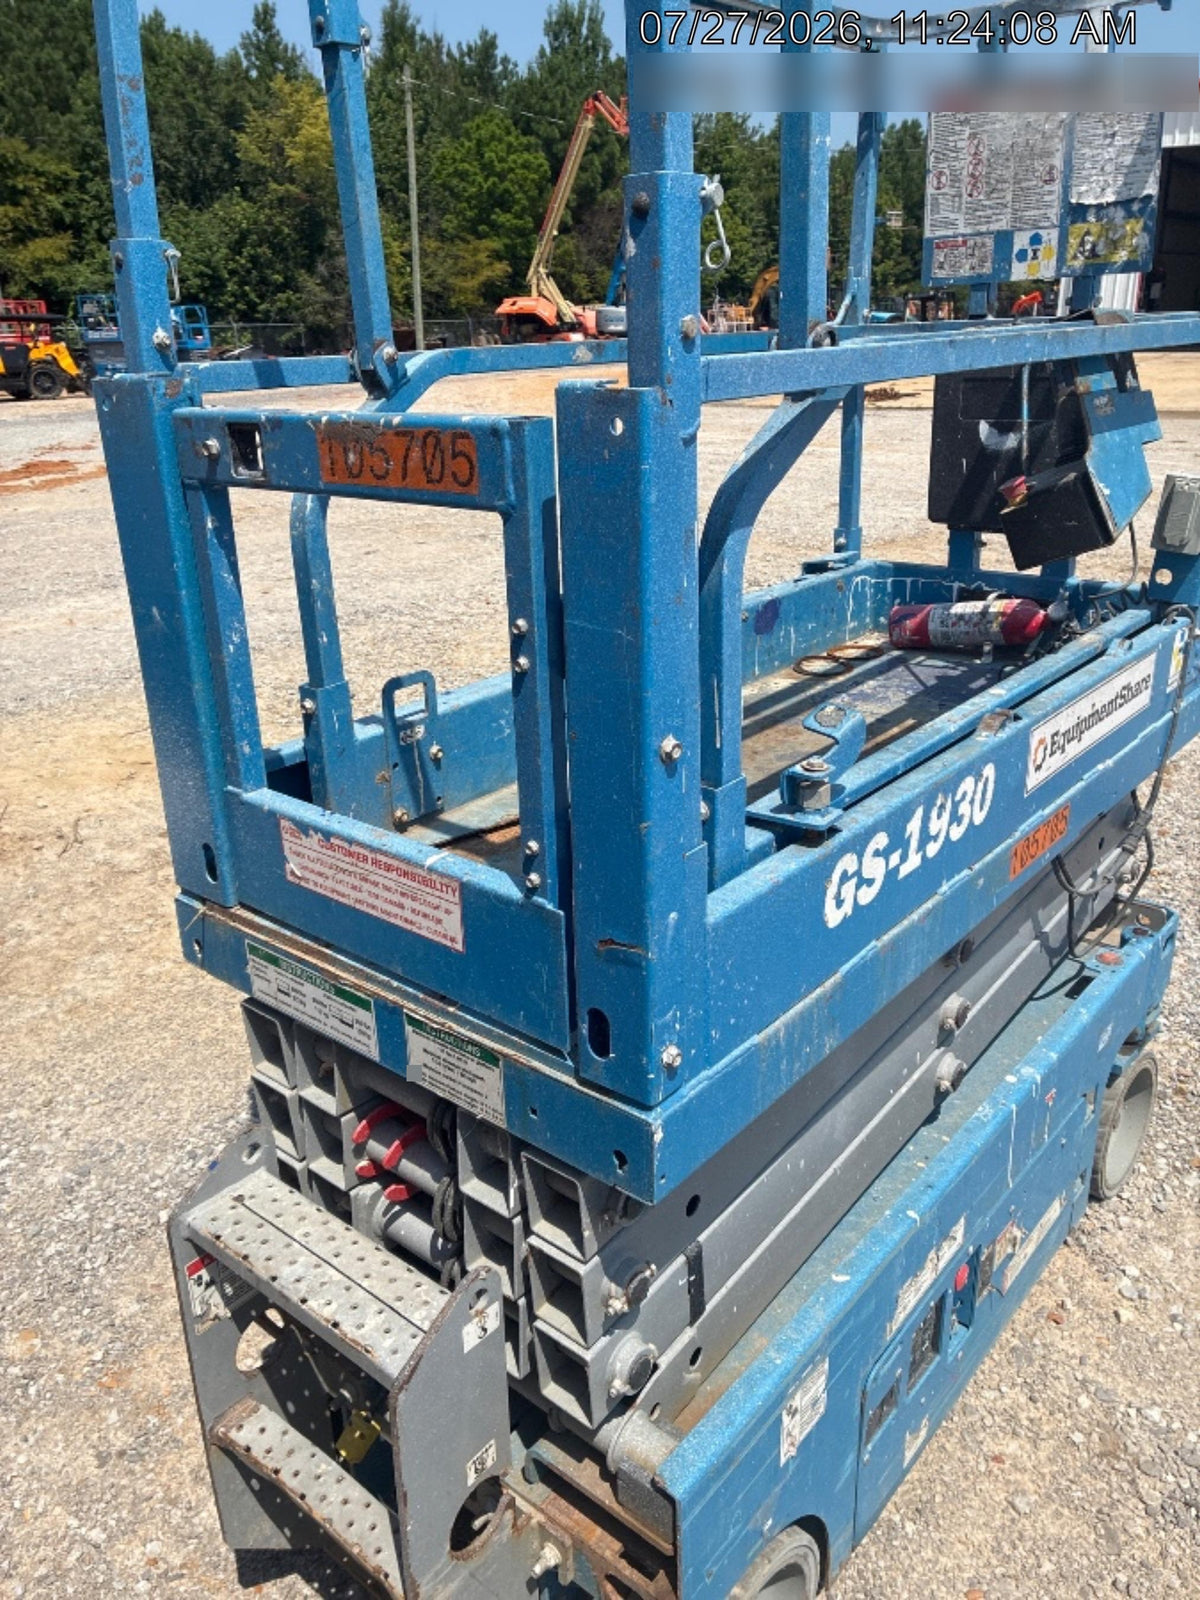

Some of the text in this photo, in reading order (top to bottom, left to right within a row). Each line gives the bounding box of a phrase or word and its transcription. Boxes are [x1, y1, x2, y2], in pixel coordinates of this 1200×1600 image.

[1048, 673, 1152, 758] EquipmentShare
[317, 838, 459, 899] CUSTOMER RESPONSIBILITY
[823, 762, 996, 929] GS-1930
